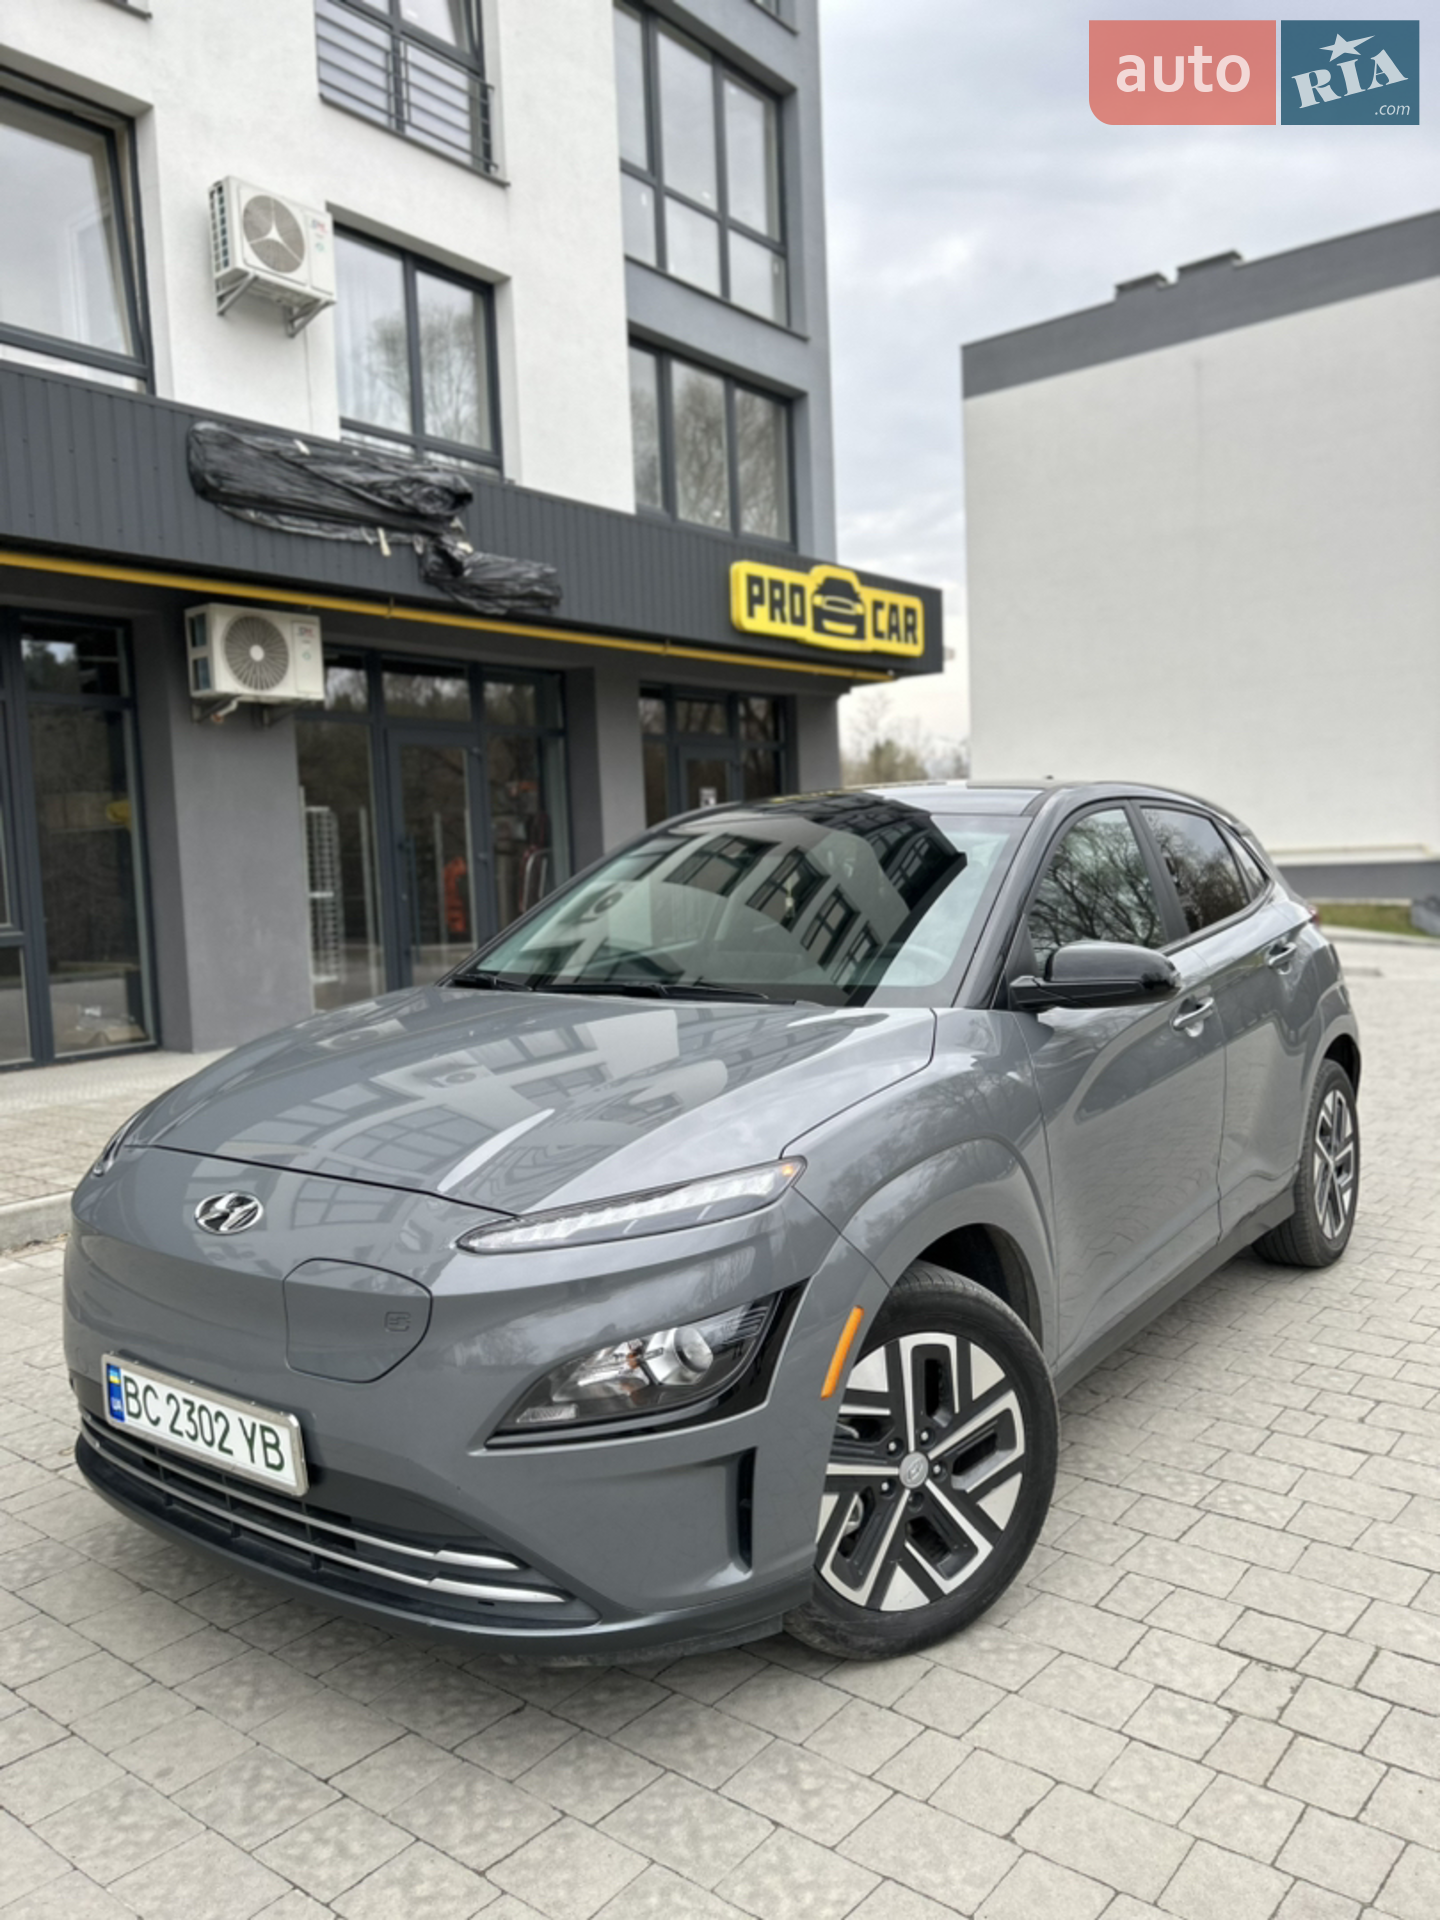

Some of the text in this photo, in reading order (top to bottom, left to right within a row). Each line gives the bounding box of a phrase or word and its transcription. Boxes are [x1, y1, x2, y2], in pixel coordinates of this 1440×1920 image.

[746, 573, 919, 646] PRO CAR
[123, 1375, 285, 1472] BC 2302 YB
